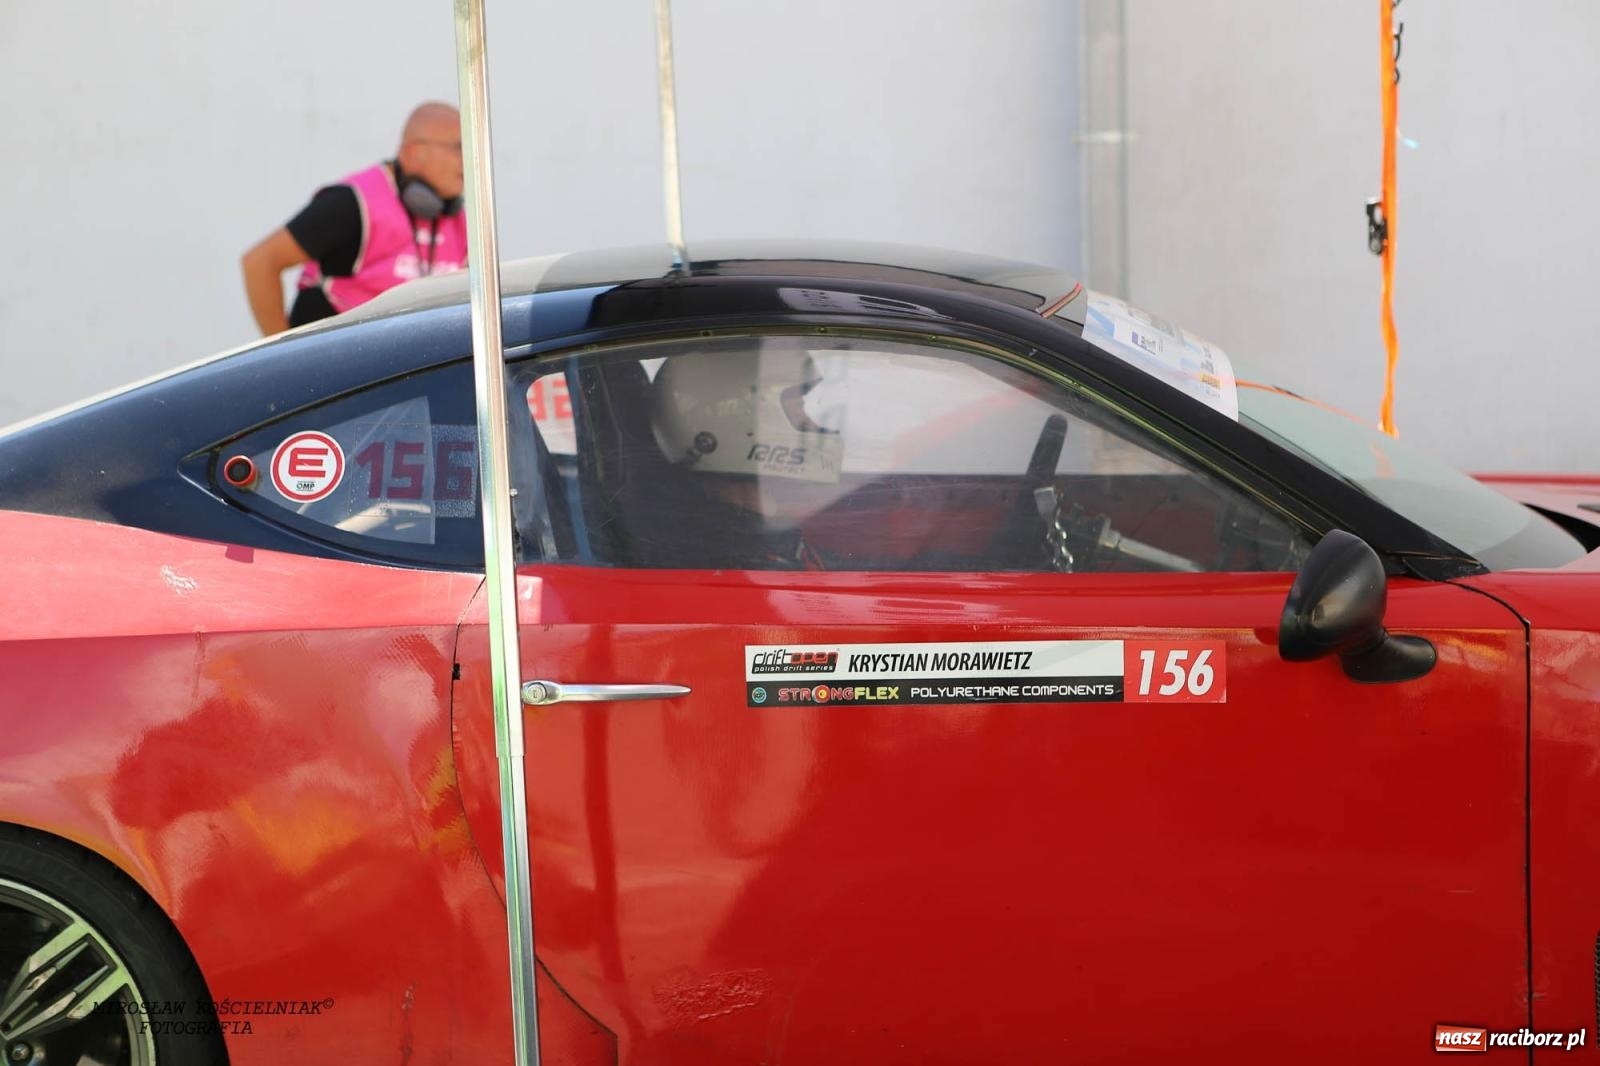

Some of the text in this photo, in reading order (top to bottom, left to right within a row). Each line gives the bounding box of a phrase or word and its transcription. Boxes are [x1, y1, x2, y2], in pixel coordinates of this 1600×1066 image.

[288, 447, 329, 477] E
[355, 440, 474, 500] 156
[296, 482, 315, 490] OMP
[754, 665, 780, 673] polish
[805, 664, 833, 672] series
[848, 651, 1033, 673] KRYSTIAN MORAWIETZ
[1138, 649, 1214, 696] 156
[778, 684, 899, 703] STRONGFLEX
[910, 684, 1114, 698] POLYURETHANE COMPONENTS
